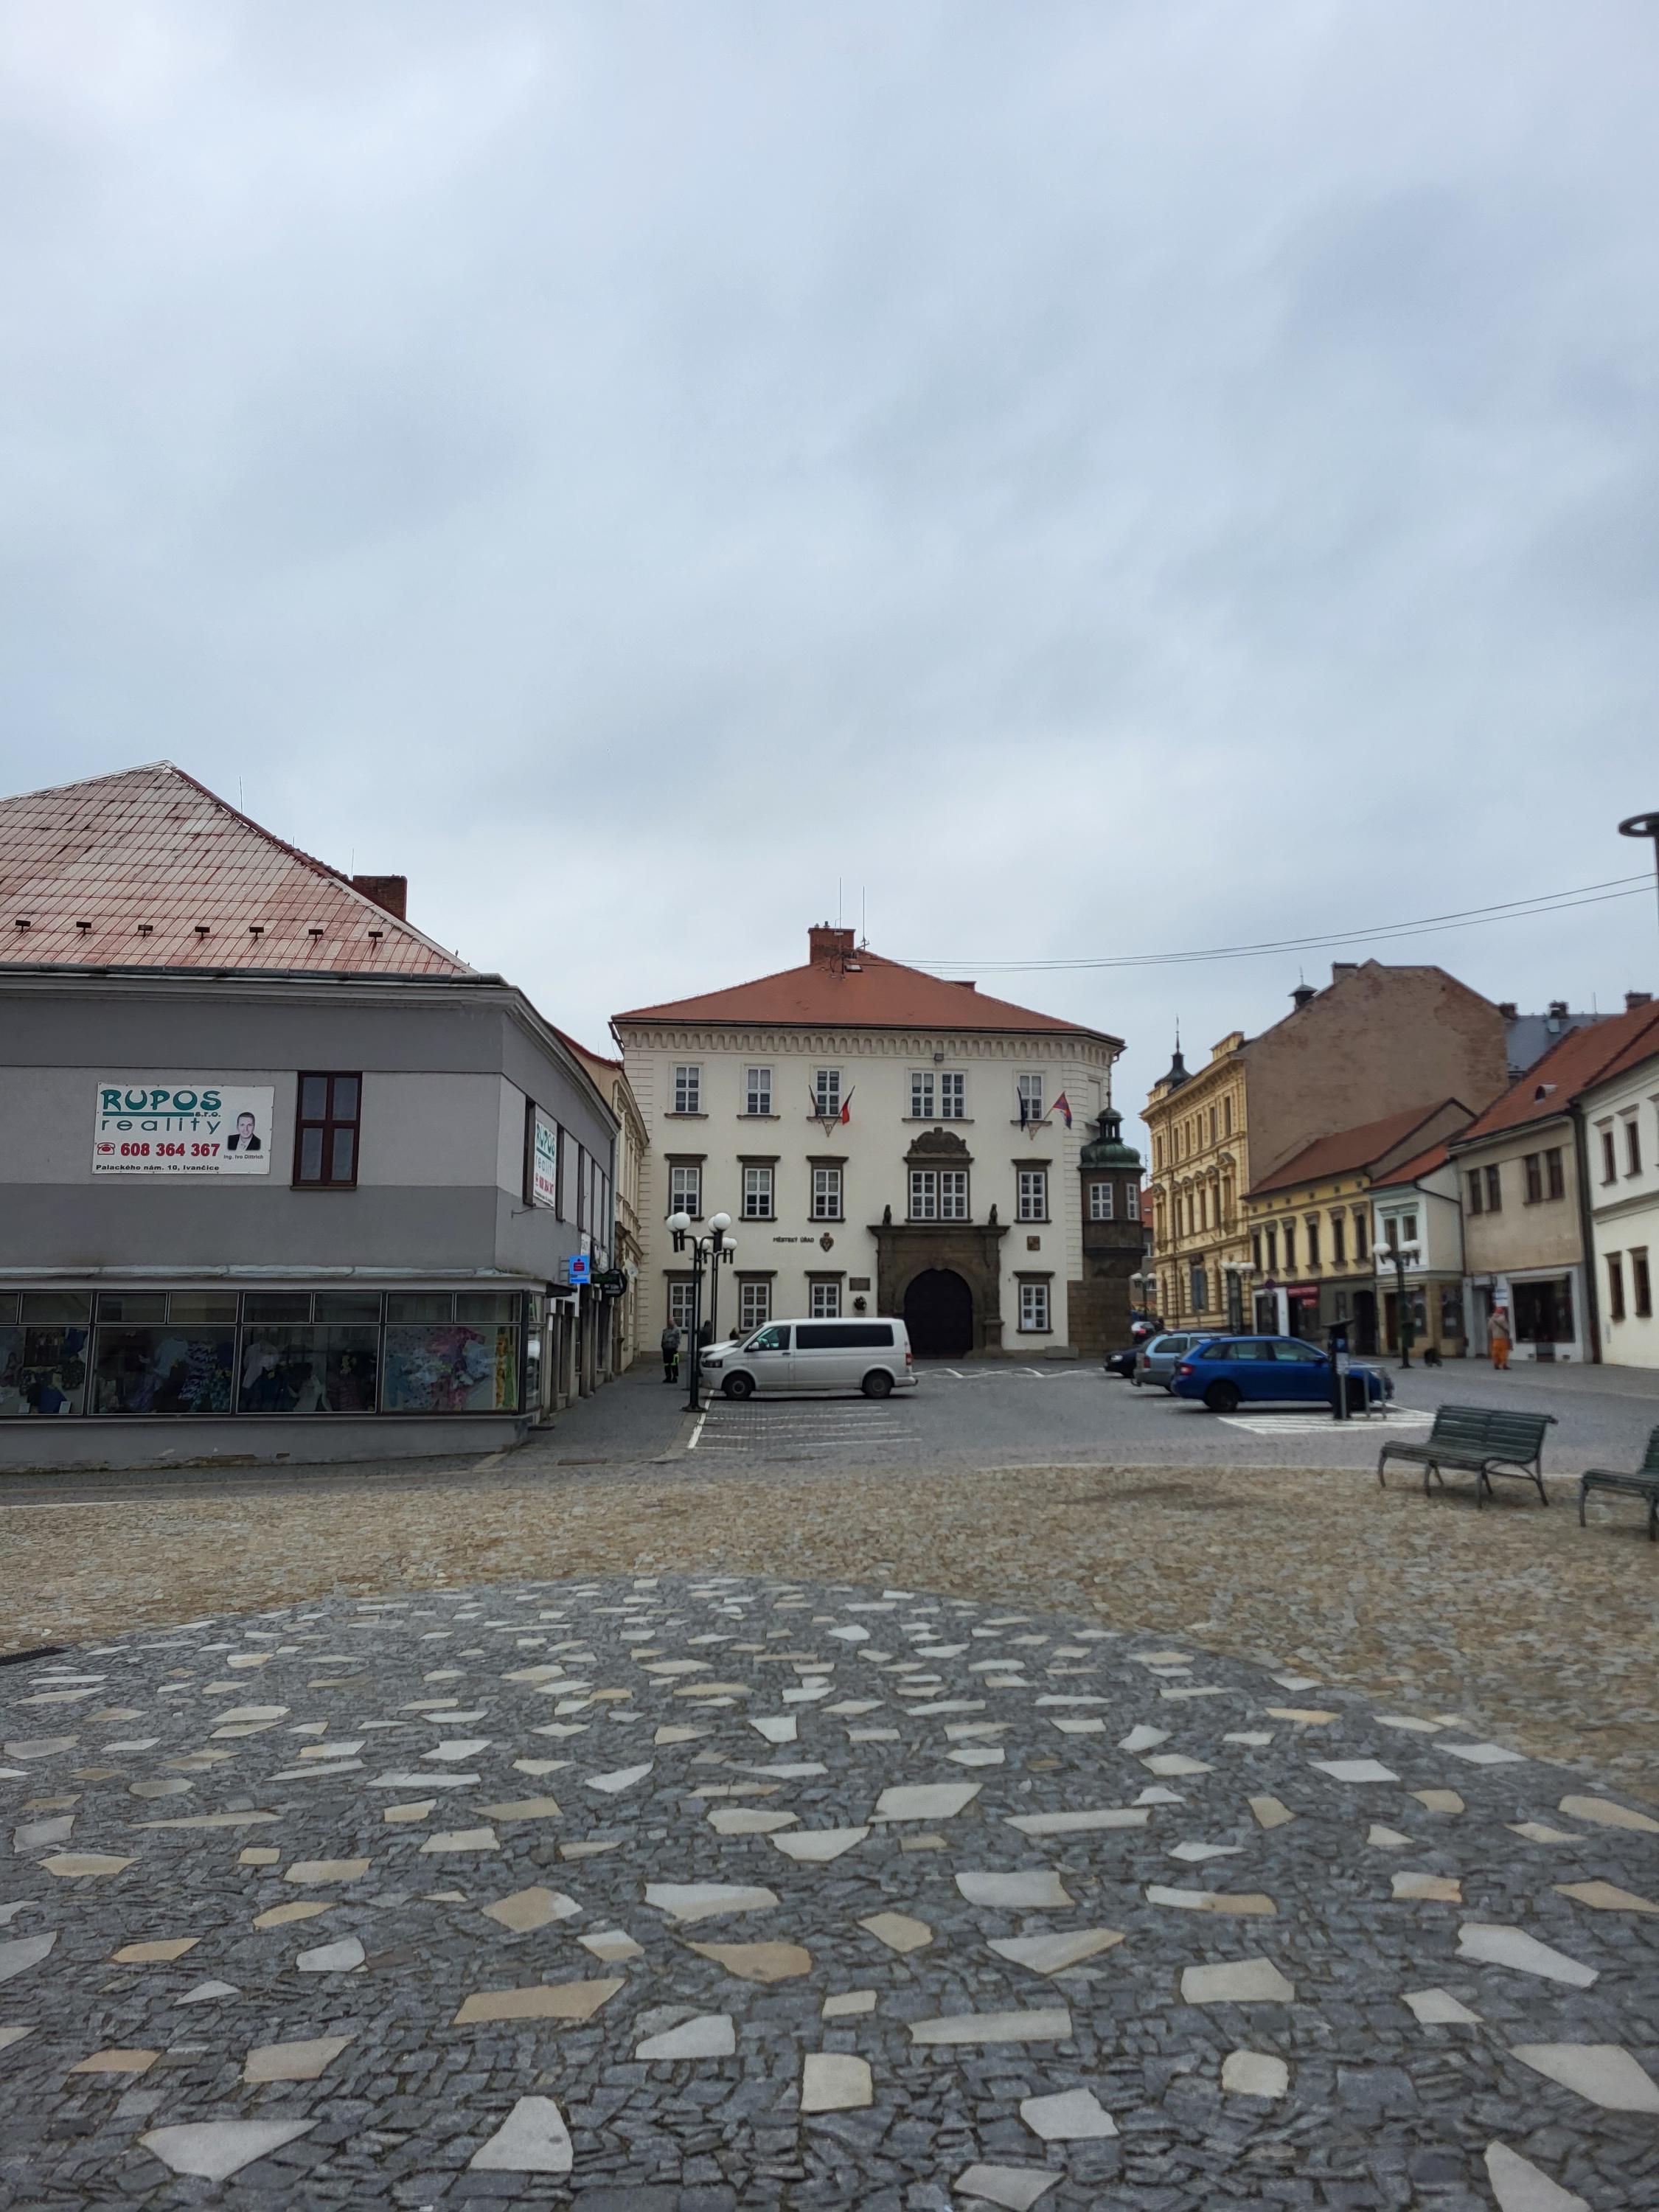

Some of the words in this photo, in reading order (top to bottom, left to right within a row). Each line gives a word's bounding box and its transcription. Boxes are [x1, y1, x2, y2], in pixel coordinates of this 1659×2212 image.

[100, 1089, 222, 1111] RUPOS
[101, 1118, 221, 1135] reality
[121, 1143, 150, 1156] 608
[156, 1143, 185, 1156] 364
[191, 1143, 220, 1156] 367
